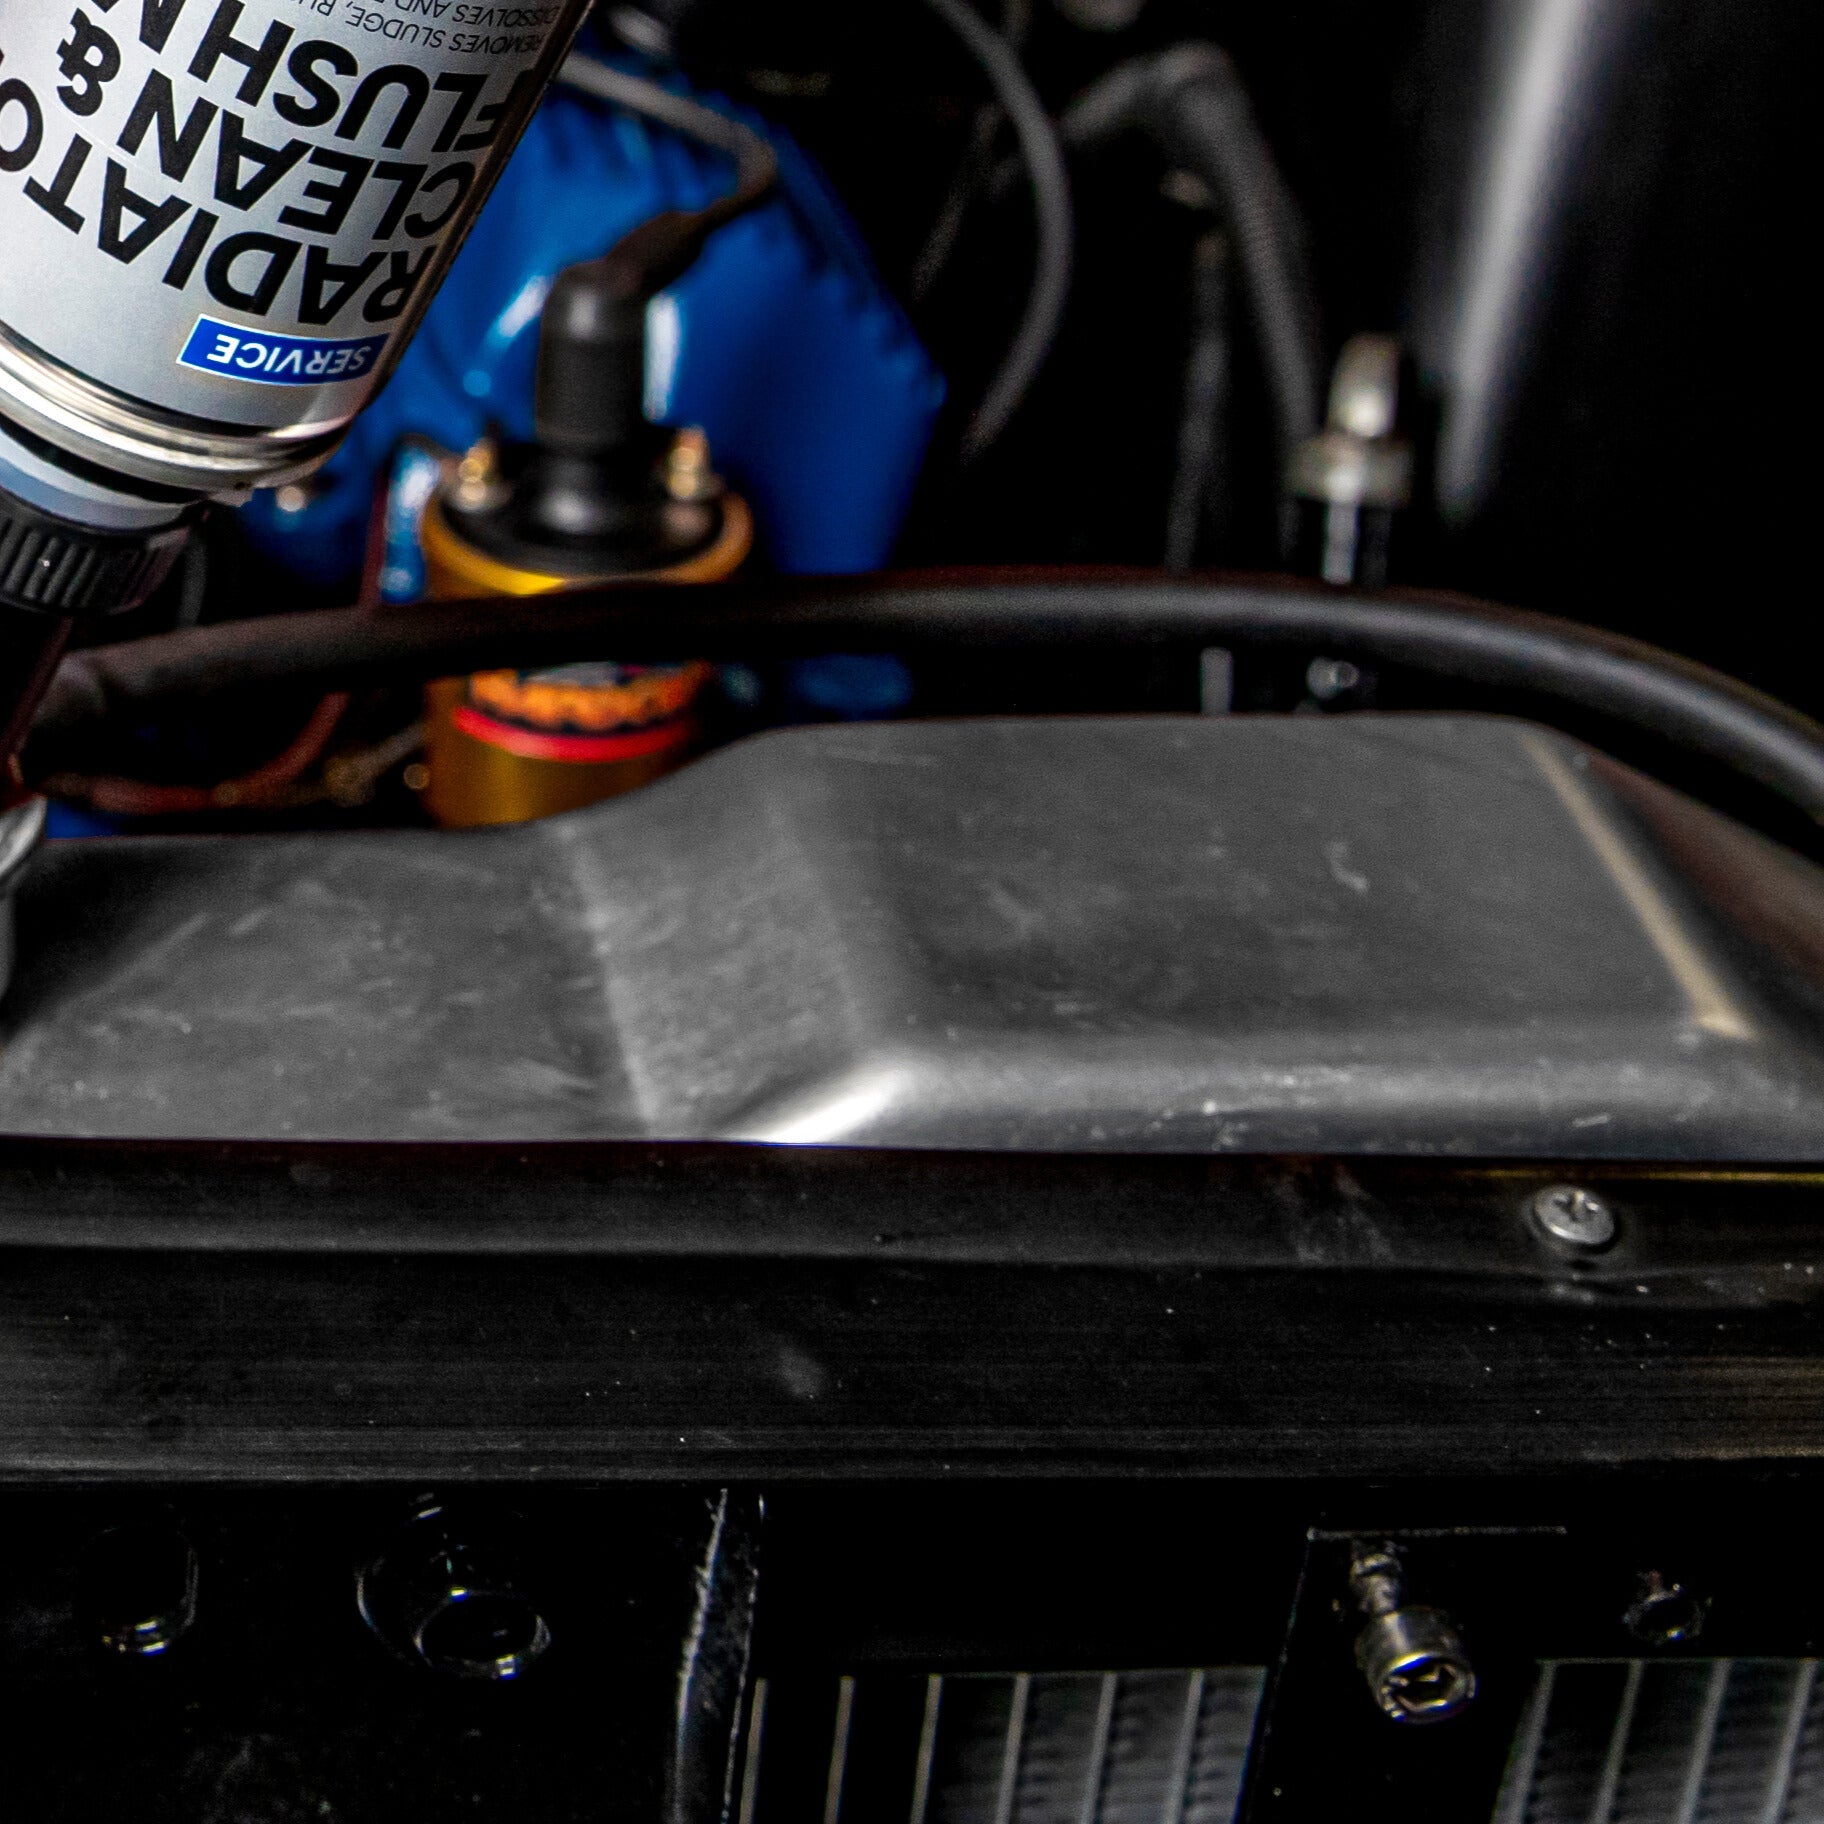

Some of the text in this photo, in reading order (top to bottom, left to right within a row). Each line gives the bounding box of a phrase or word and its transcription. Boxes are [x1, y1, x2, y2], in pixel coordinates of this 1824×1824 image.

[344, 0, 446, 47] SLUDGE,
[451, 5, 557, 24] DISSOLVES
[448, 32, 541, 52] REMOVES
[55, 6, 475, 244] CLEAN &
[206, 331, 372, 374] SERVICE
